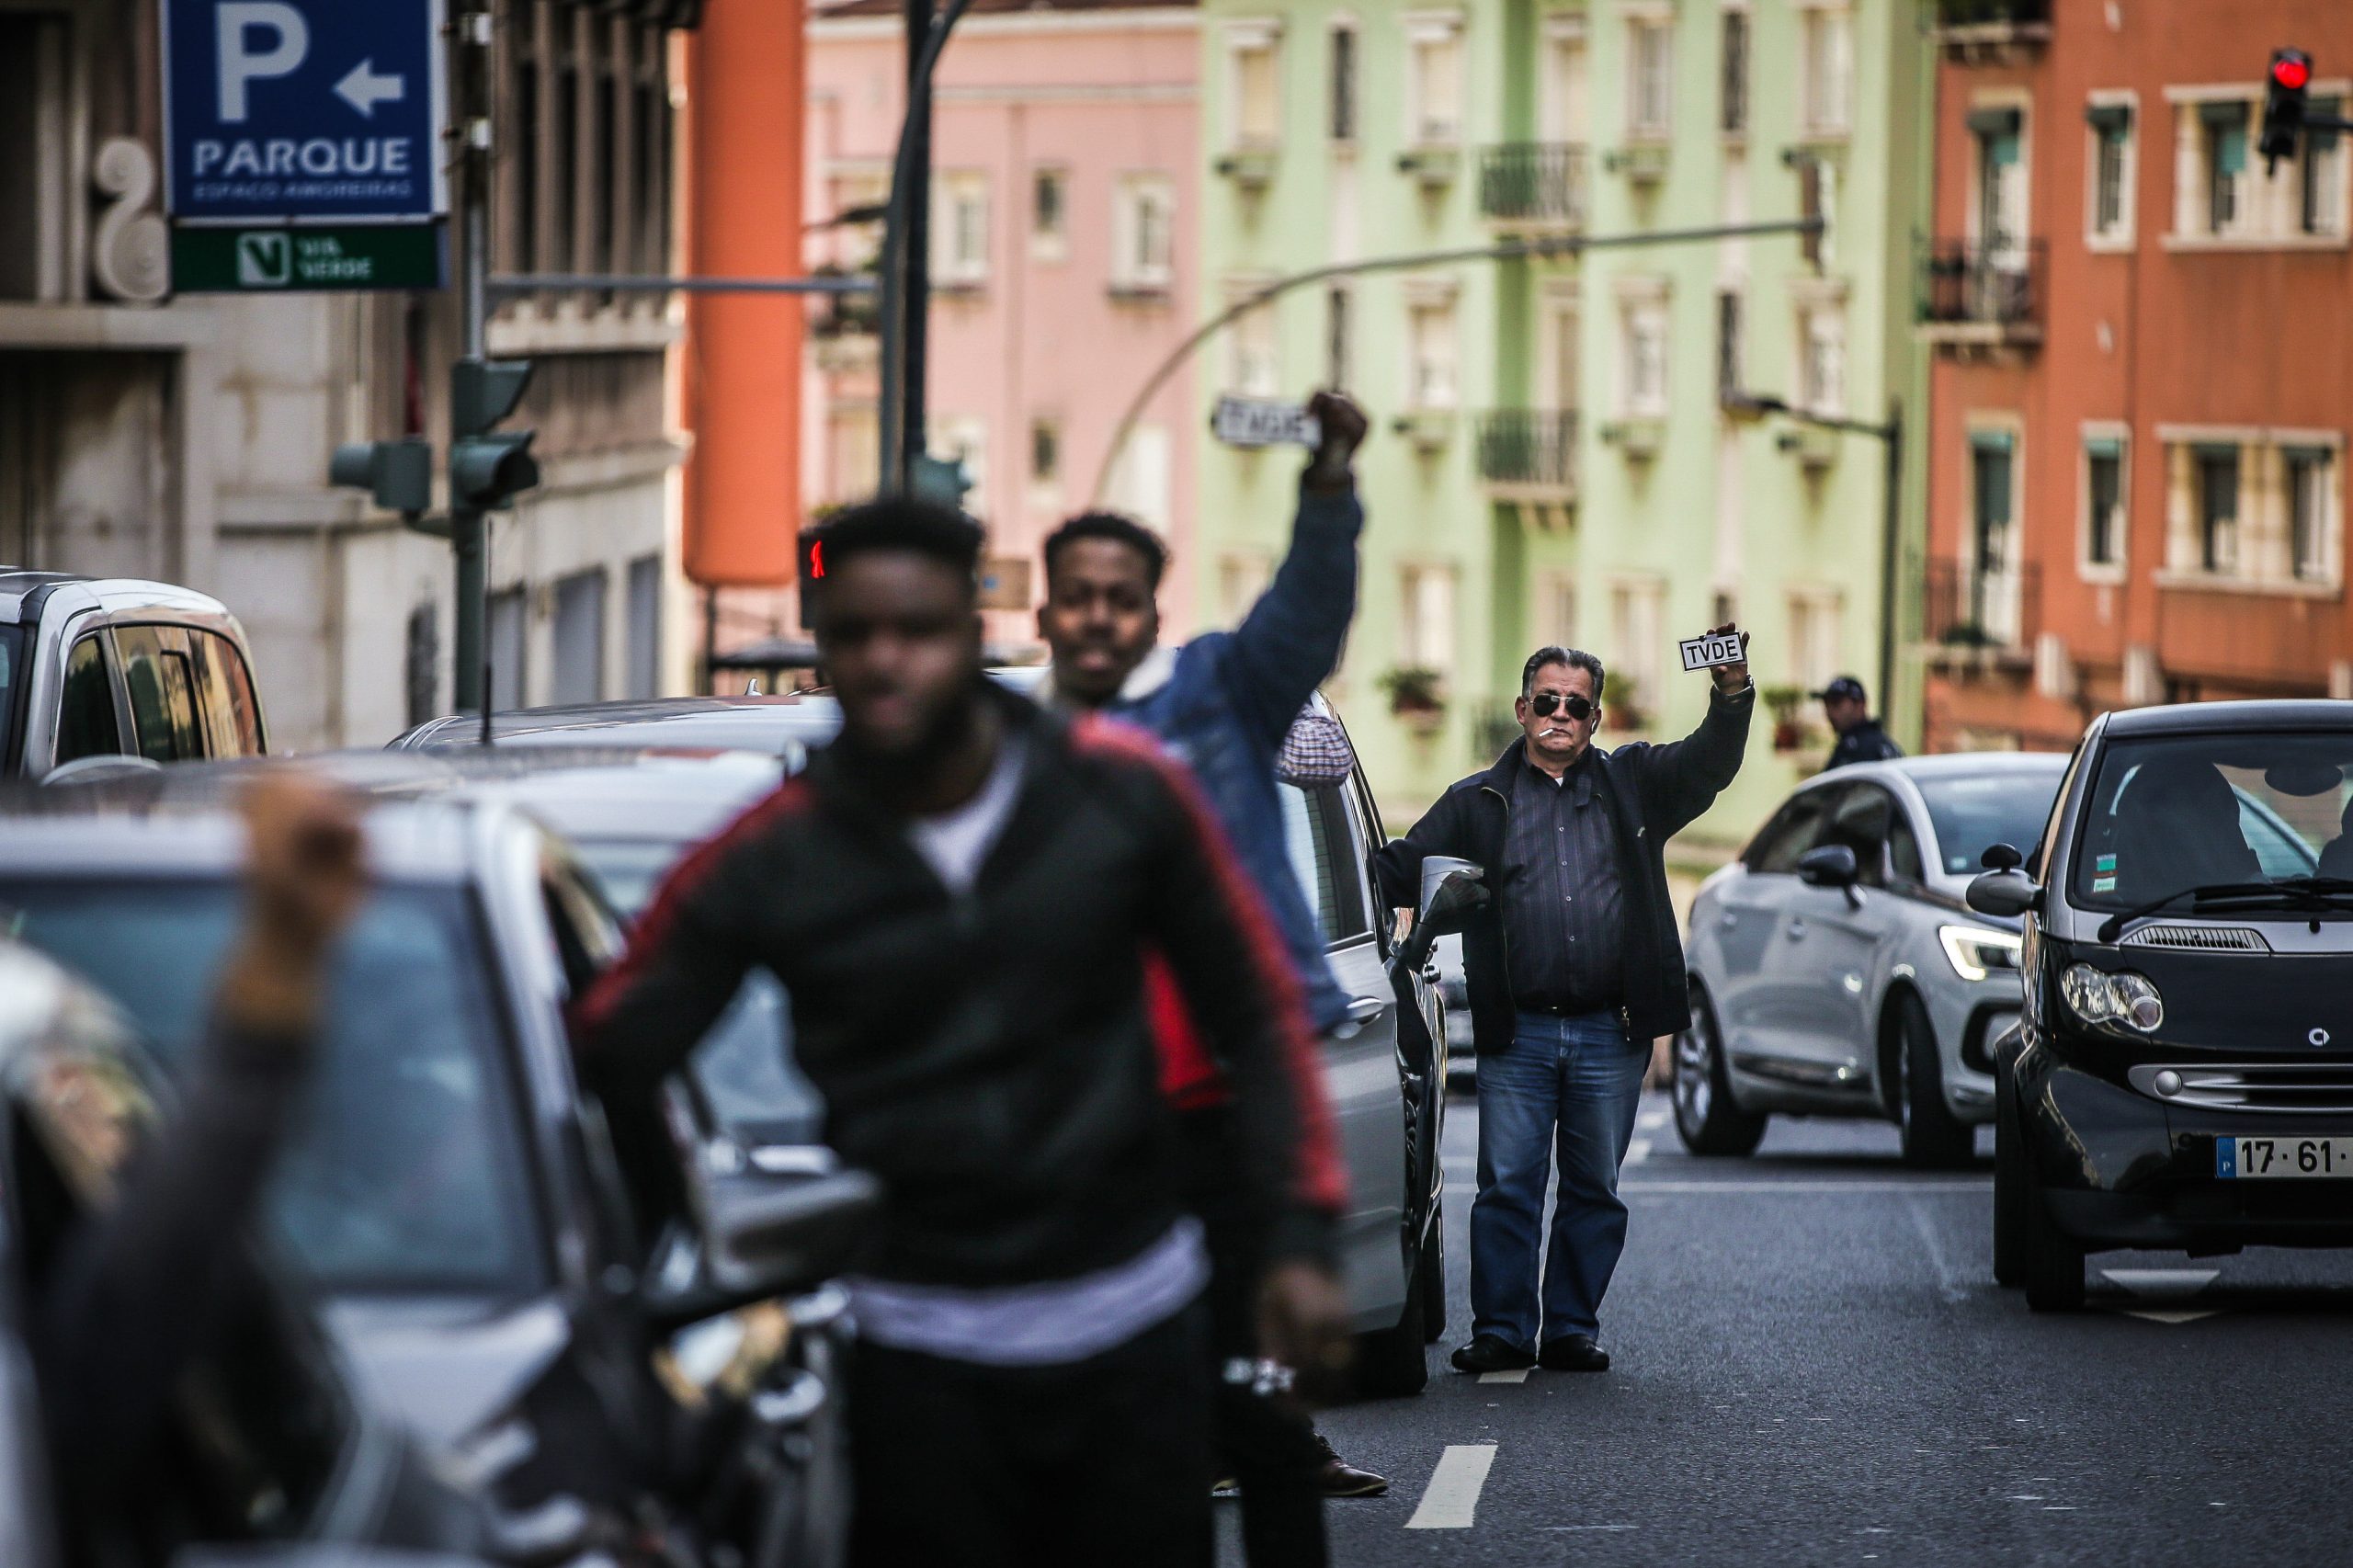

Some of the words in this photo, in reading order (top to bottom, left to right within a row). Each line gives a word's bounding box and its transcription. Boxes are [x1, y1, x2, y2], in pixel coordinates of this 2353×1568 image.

[215, 3, 310, 123] P
[192, 138, 412, 176] PARQUE
[1687, 639, 1738, 664] TVDE
[2222, 1161, 2231, 1172] P
